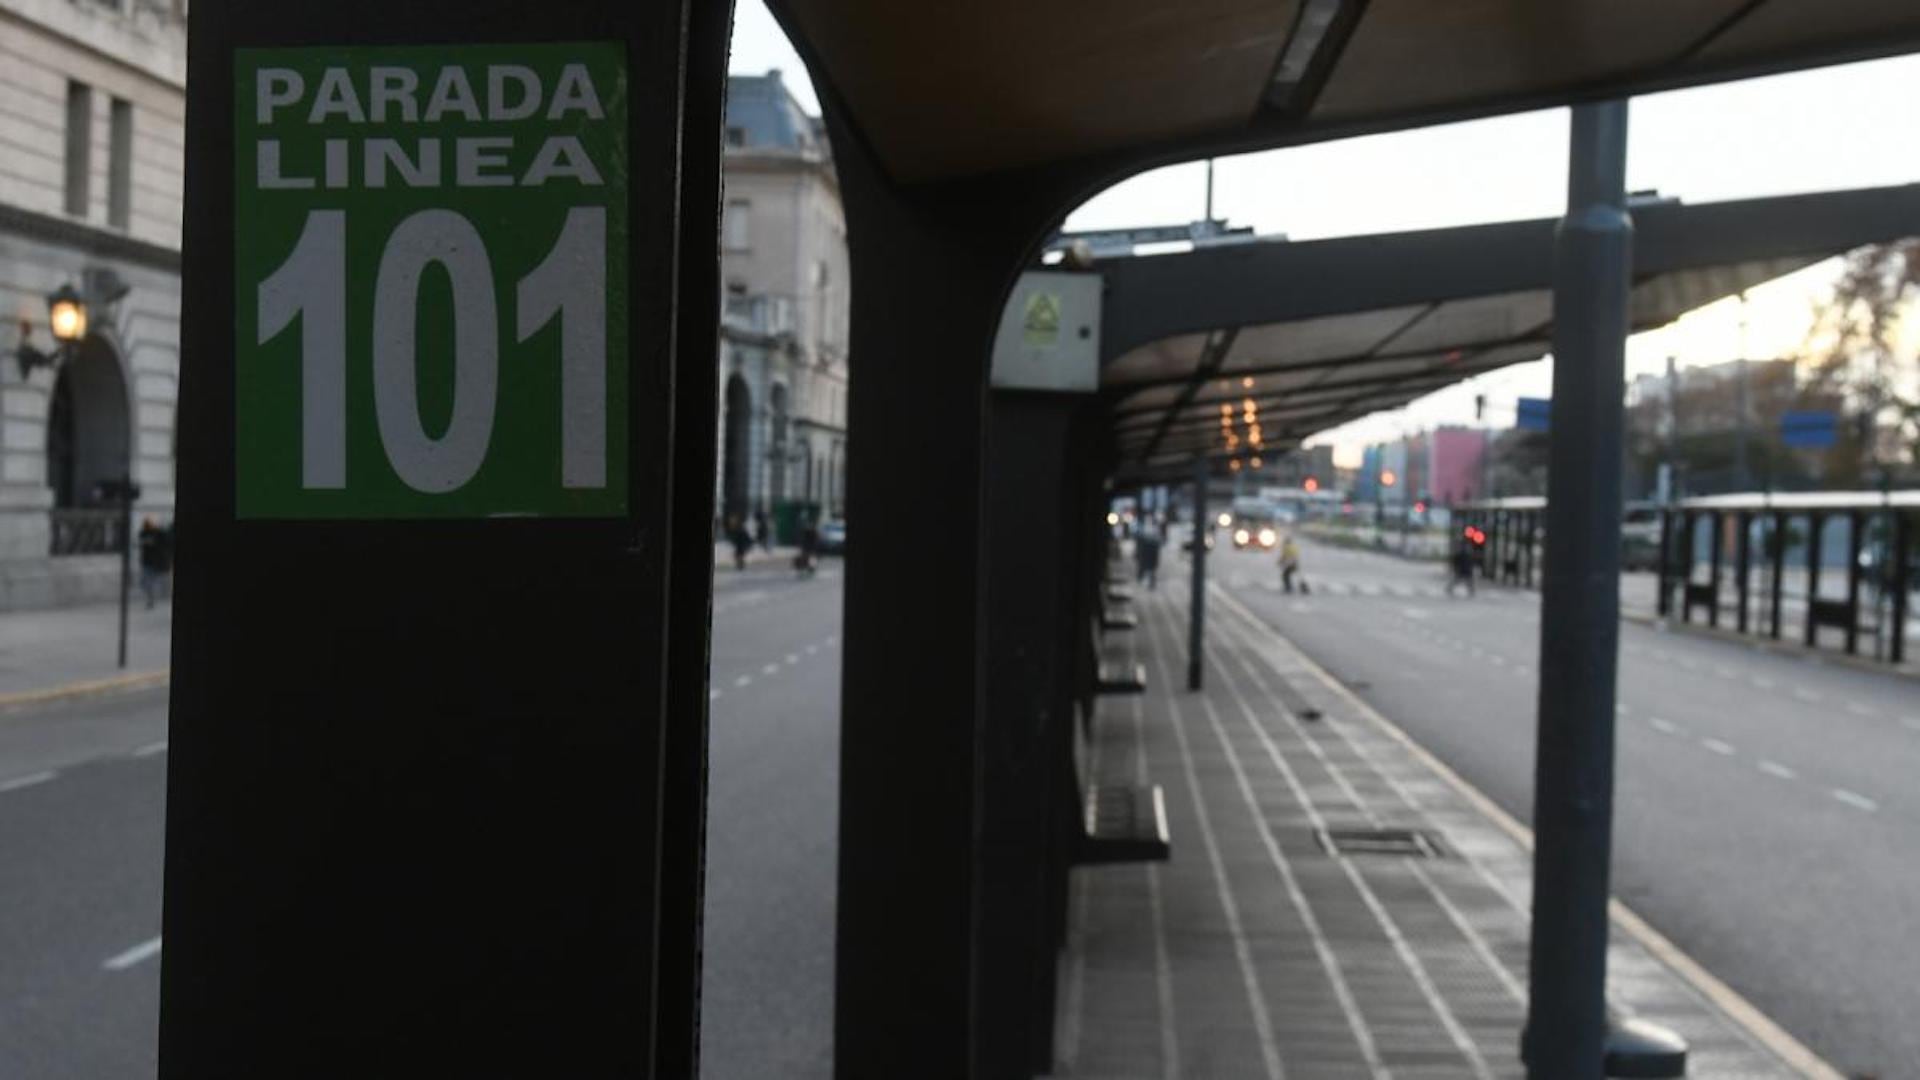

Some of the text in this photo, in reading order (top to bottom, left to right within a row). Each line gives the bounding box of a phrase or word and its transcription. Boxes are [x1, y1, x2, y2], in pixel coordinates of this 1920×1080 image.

[256, 63, 605, 124] PARADA
[257, 136, 605, 188] LINEA
[257, 207, 606, 494] 101
